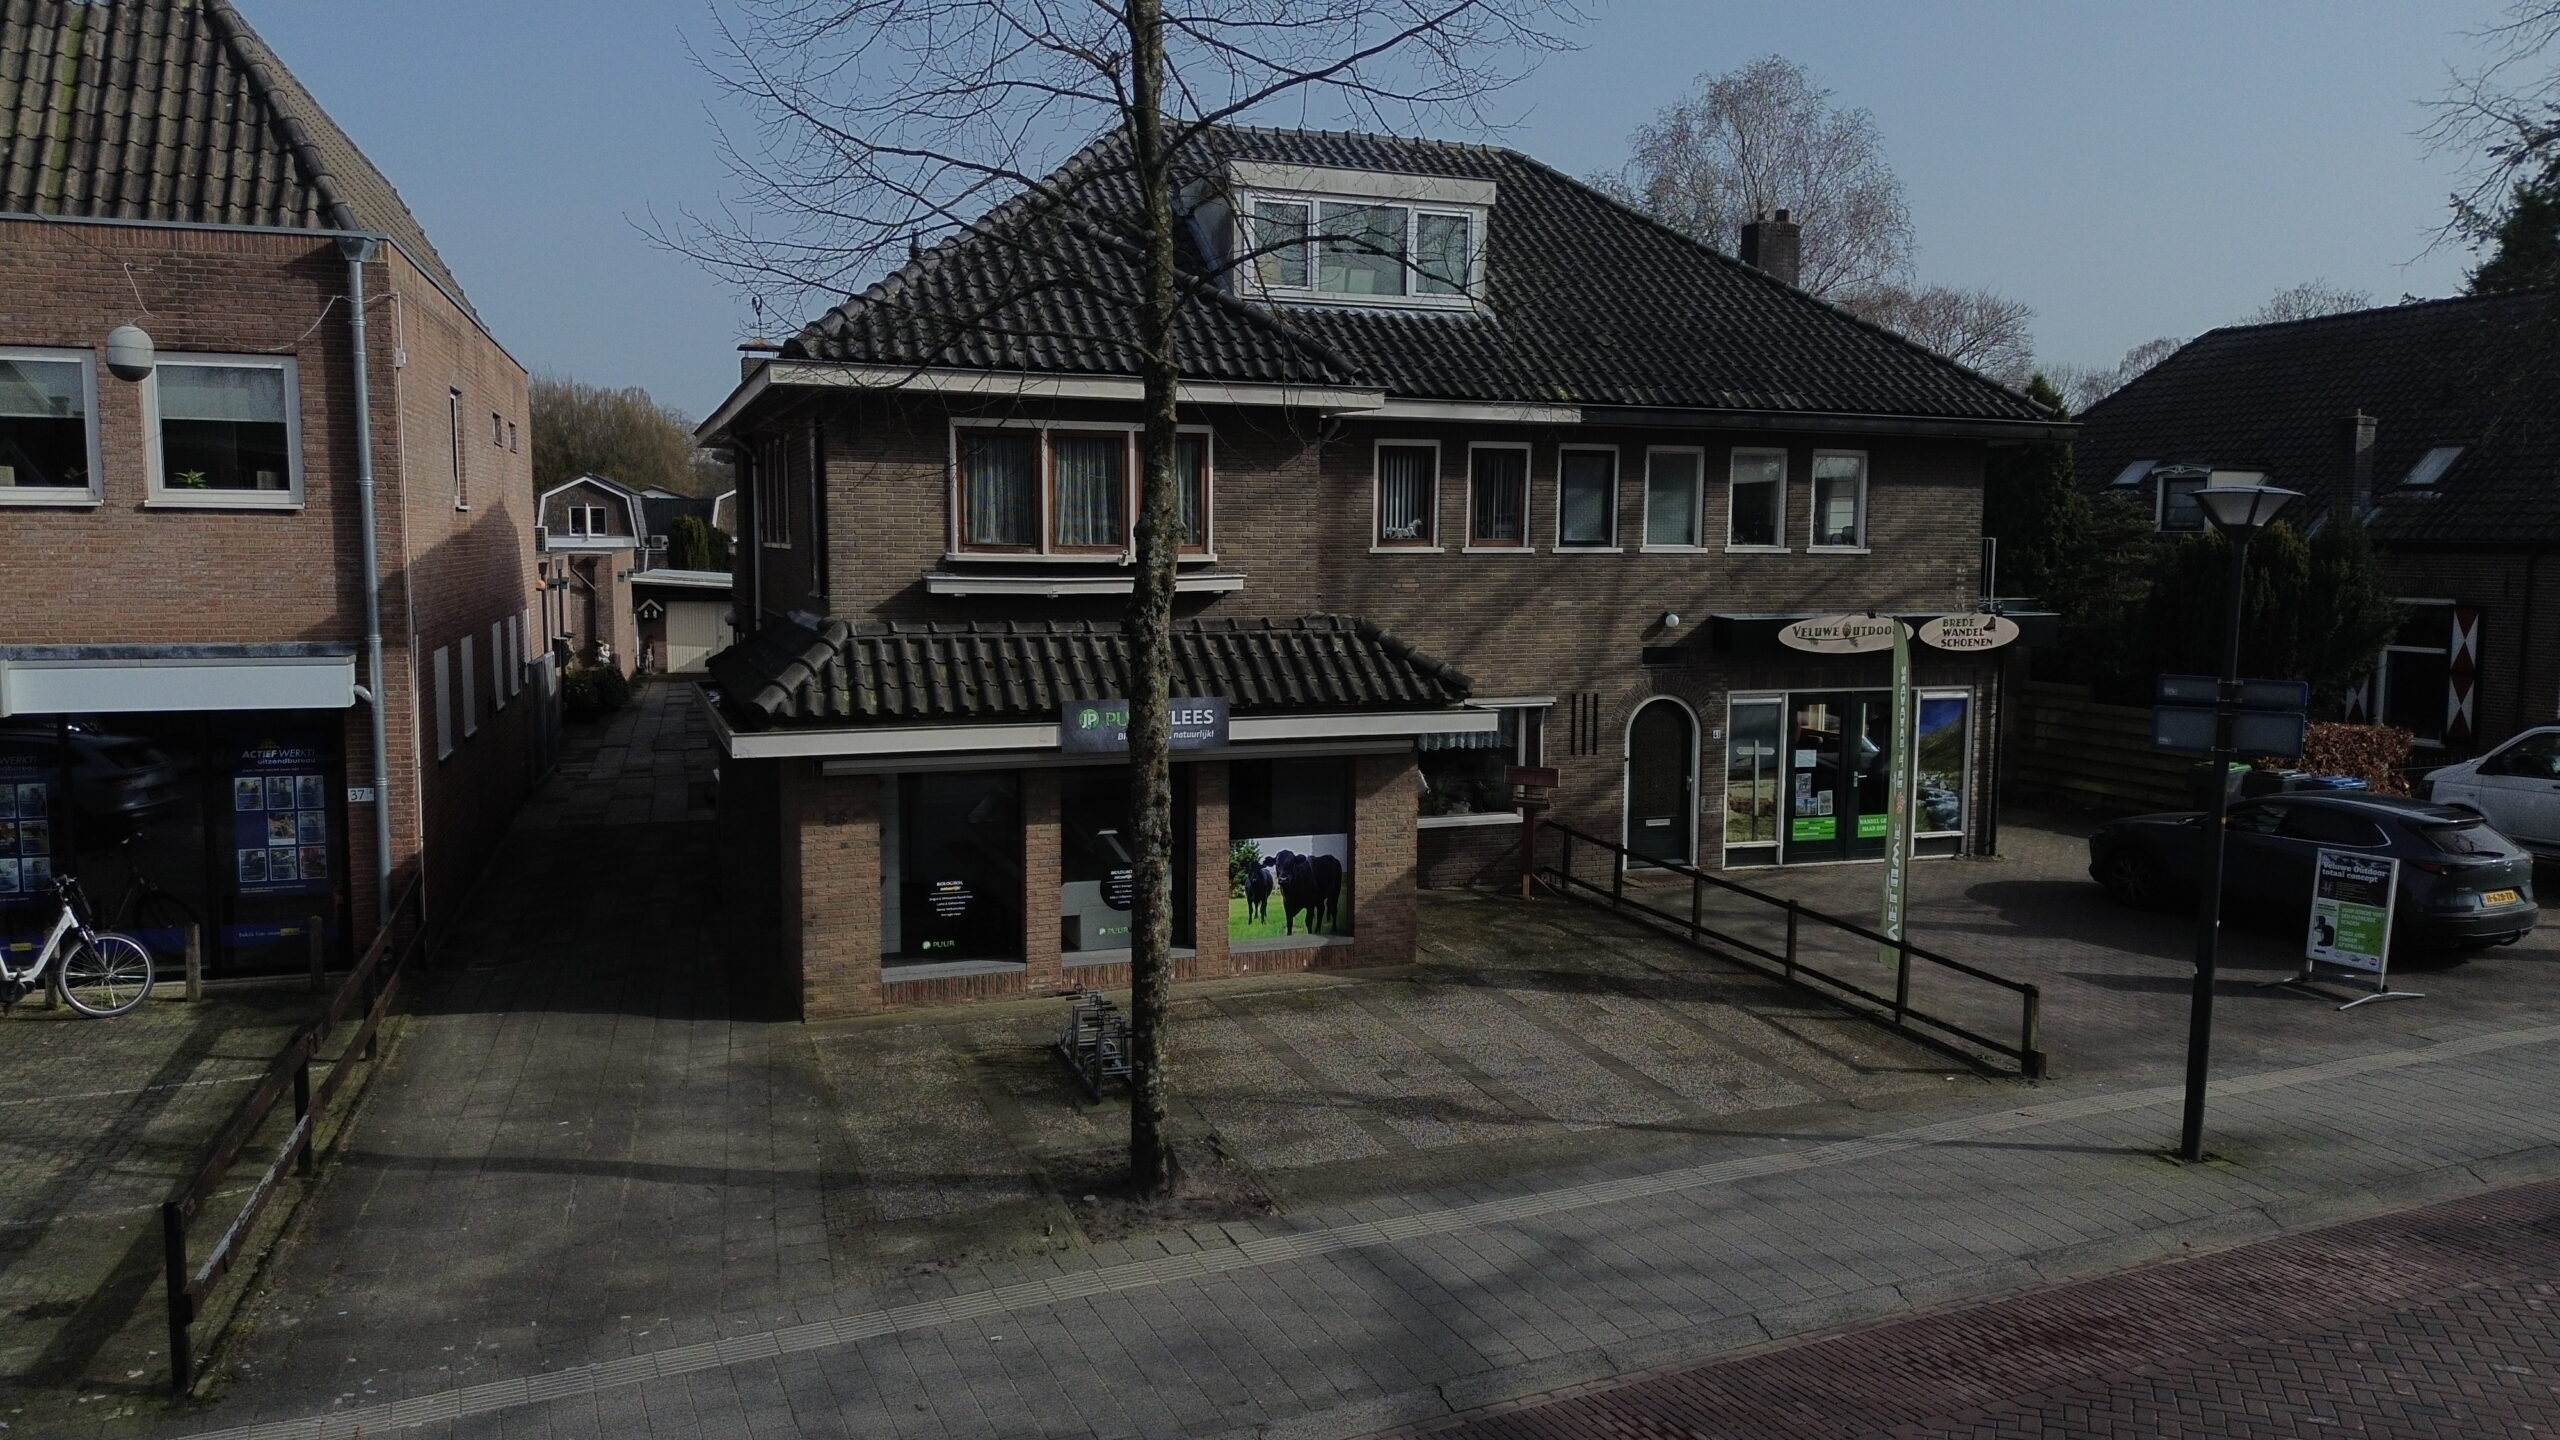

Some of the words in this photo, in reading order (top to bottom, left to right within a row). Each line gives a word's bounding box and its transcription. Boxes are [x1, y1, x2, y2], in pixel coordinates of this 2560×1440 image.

[1943, 618, 1975, 627] BREDE
[1793, 625, 1839, 637] VELUWE
[1943, 628, 1985, 637] WANDEL
[1941, 638, 1993, 647] SCHOENEN
[1168, 709, 1215, 725] LEES
[1173, 729, 1214, 740] natuurlijk!
[241, 749, 278, 759] ACTIEF
[257, 757, 317, 765] uitzendbureau
[350, 790, 365, 801] 37
[2322, 861, 2352, 872] Veluwe
[2353, 866, 2387, 877] Outdoor
[2322, 868, 2346, 878] totaal
[2346, 873, 2379, 883] concept
